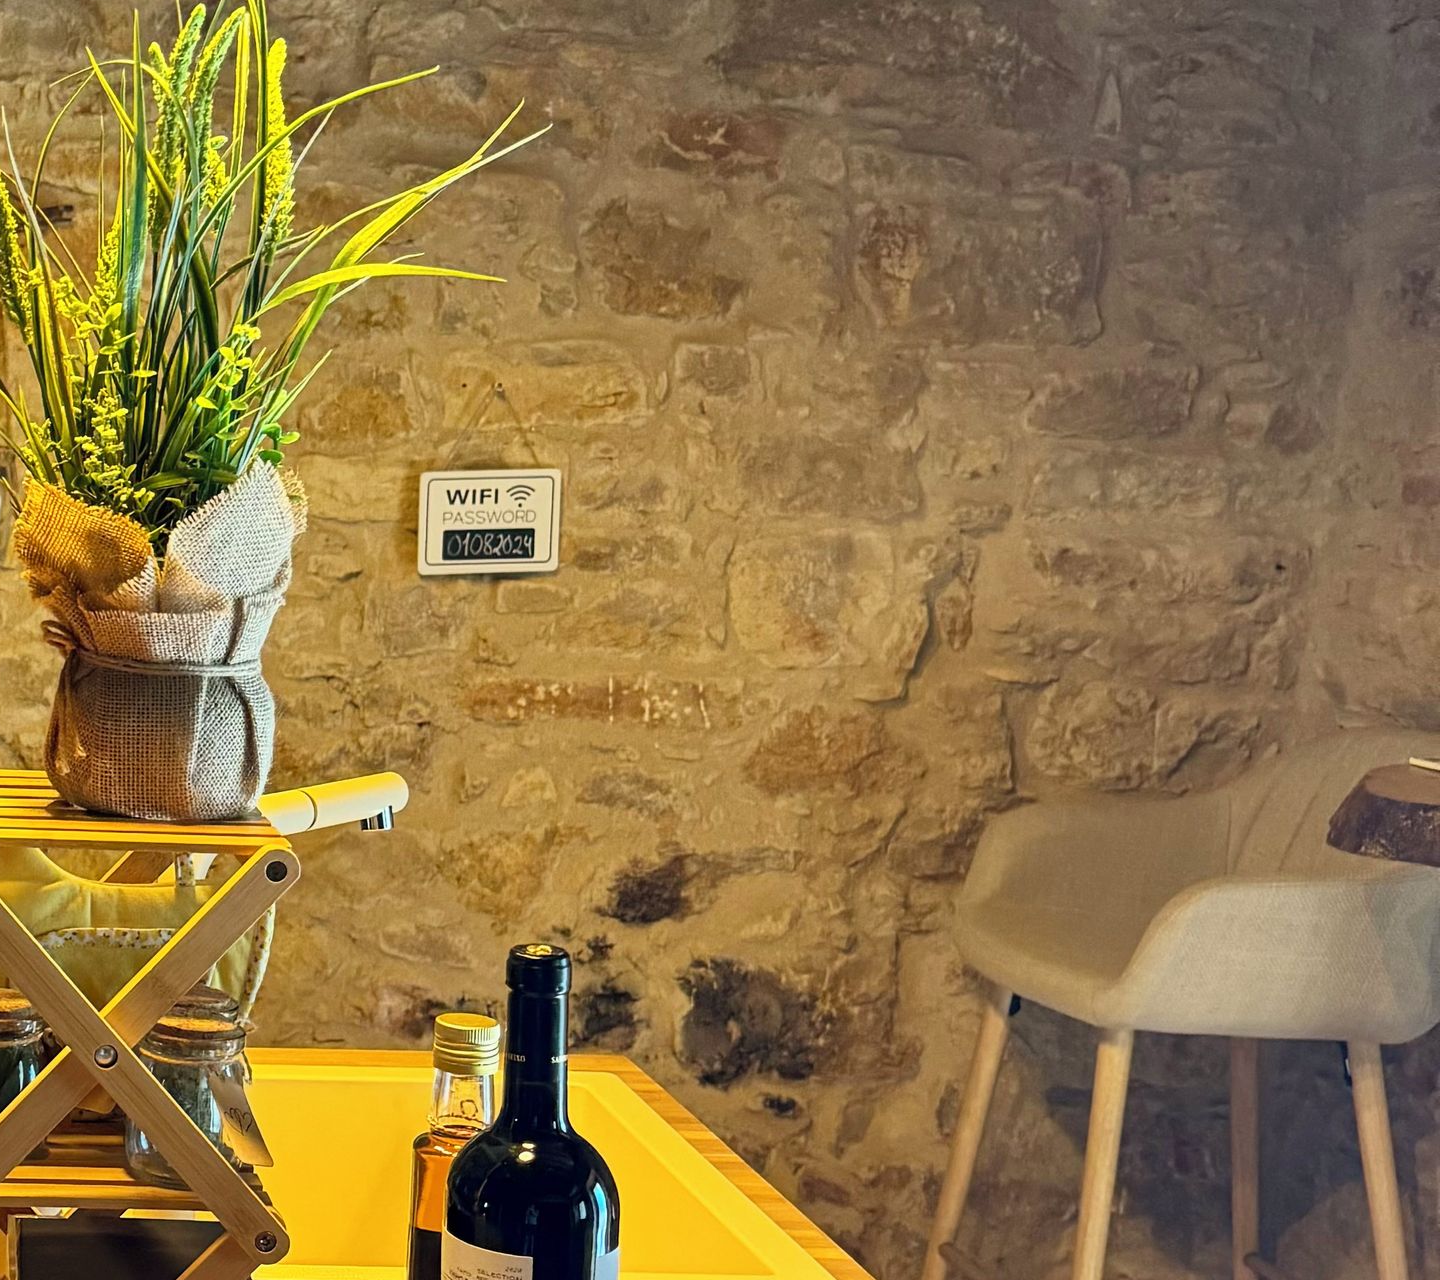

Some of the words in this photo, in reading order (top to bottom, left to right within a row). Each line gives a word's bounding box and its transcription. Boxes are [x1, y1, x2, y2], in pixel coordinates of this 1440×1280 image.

[446, 488, 499, 505] WIFI
[442, 509, 537, 525] PASSWORD
[447, 532, 533, 557] 01082024
